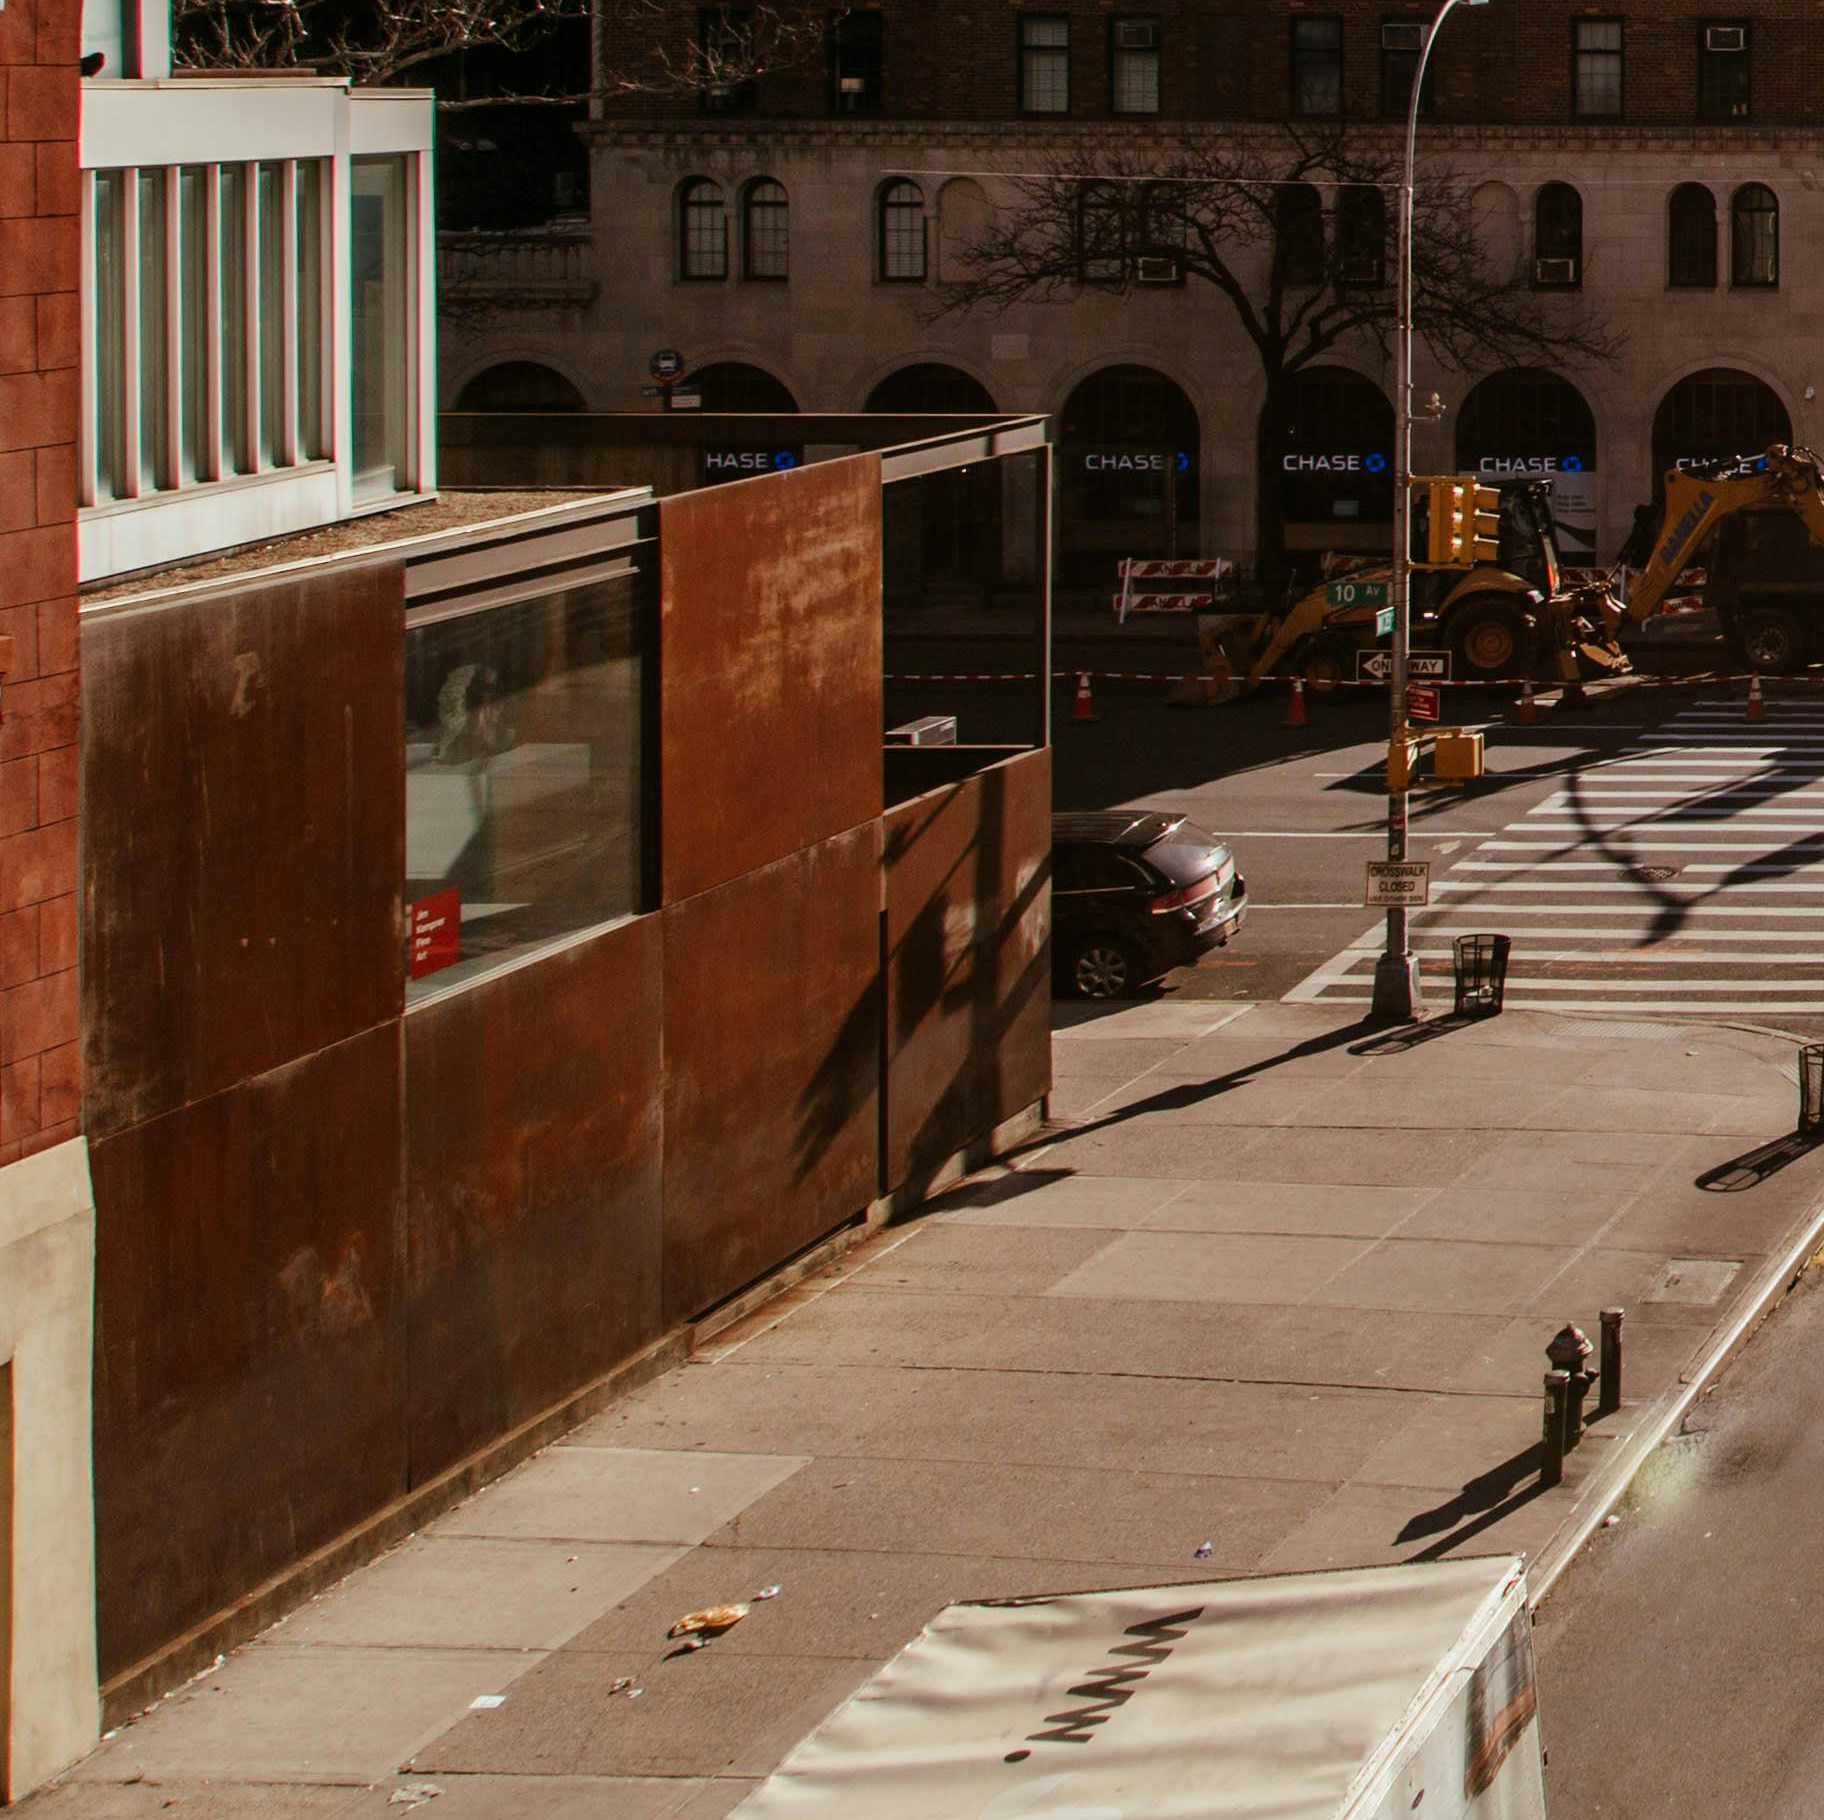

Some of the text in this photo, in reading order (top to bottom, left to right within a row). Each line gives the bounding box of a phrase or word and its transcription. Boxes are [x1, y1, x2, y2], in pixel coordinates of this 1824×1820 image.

[706, 452, 768, 469] HASE
[1085, 453, 1164, 471] CHASE
[1282, 454, 1361, 471] CHASE
[1480, 456, 1558, 473] CHASE
[1335, 584, 1380, 602] 10 Av
[1407, 659, 1438, 671] WAY
[1370, 866, 1426, 877] CROSSWALK
[1378, 881, 1416, 892] CLOSED
